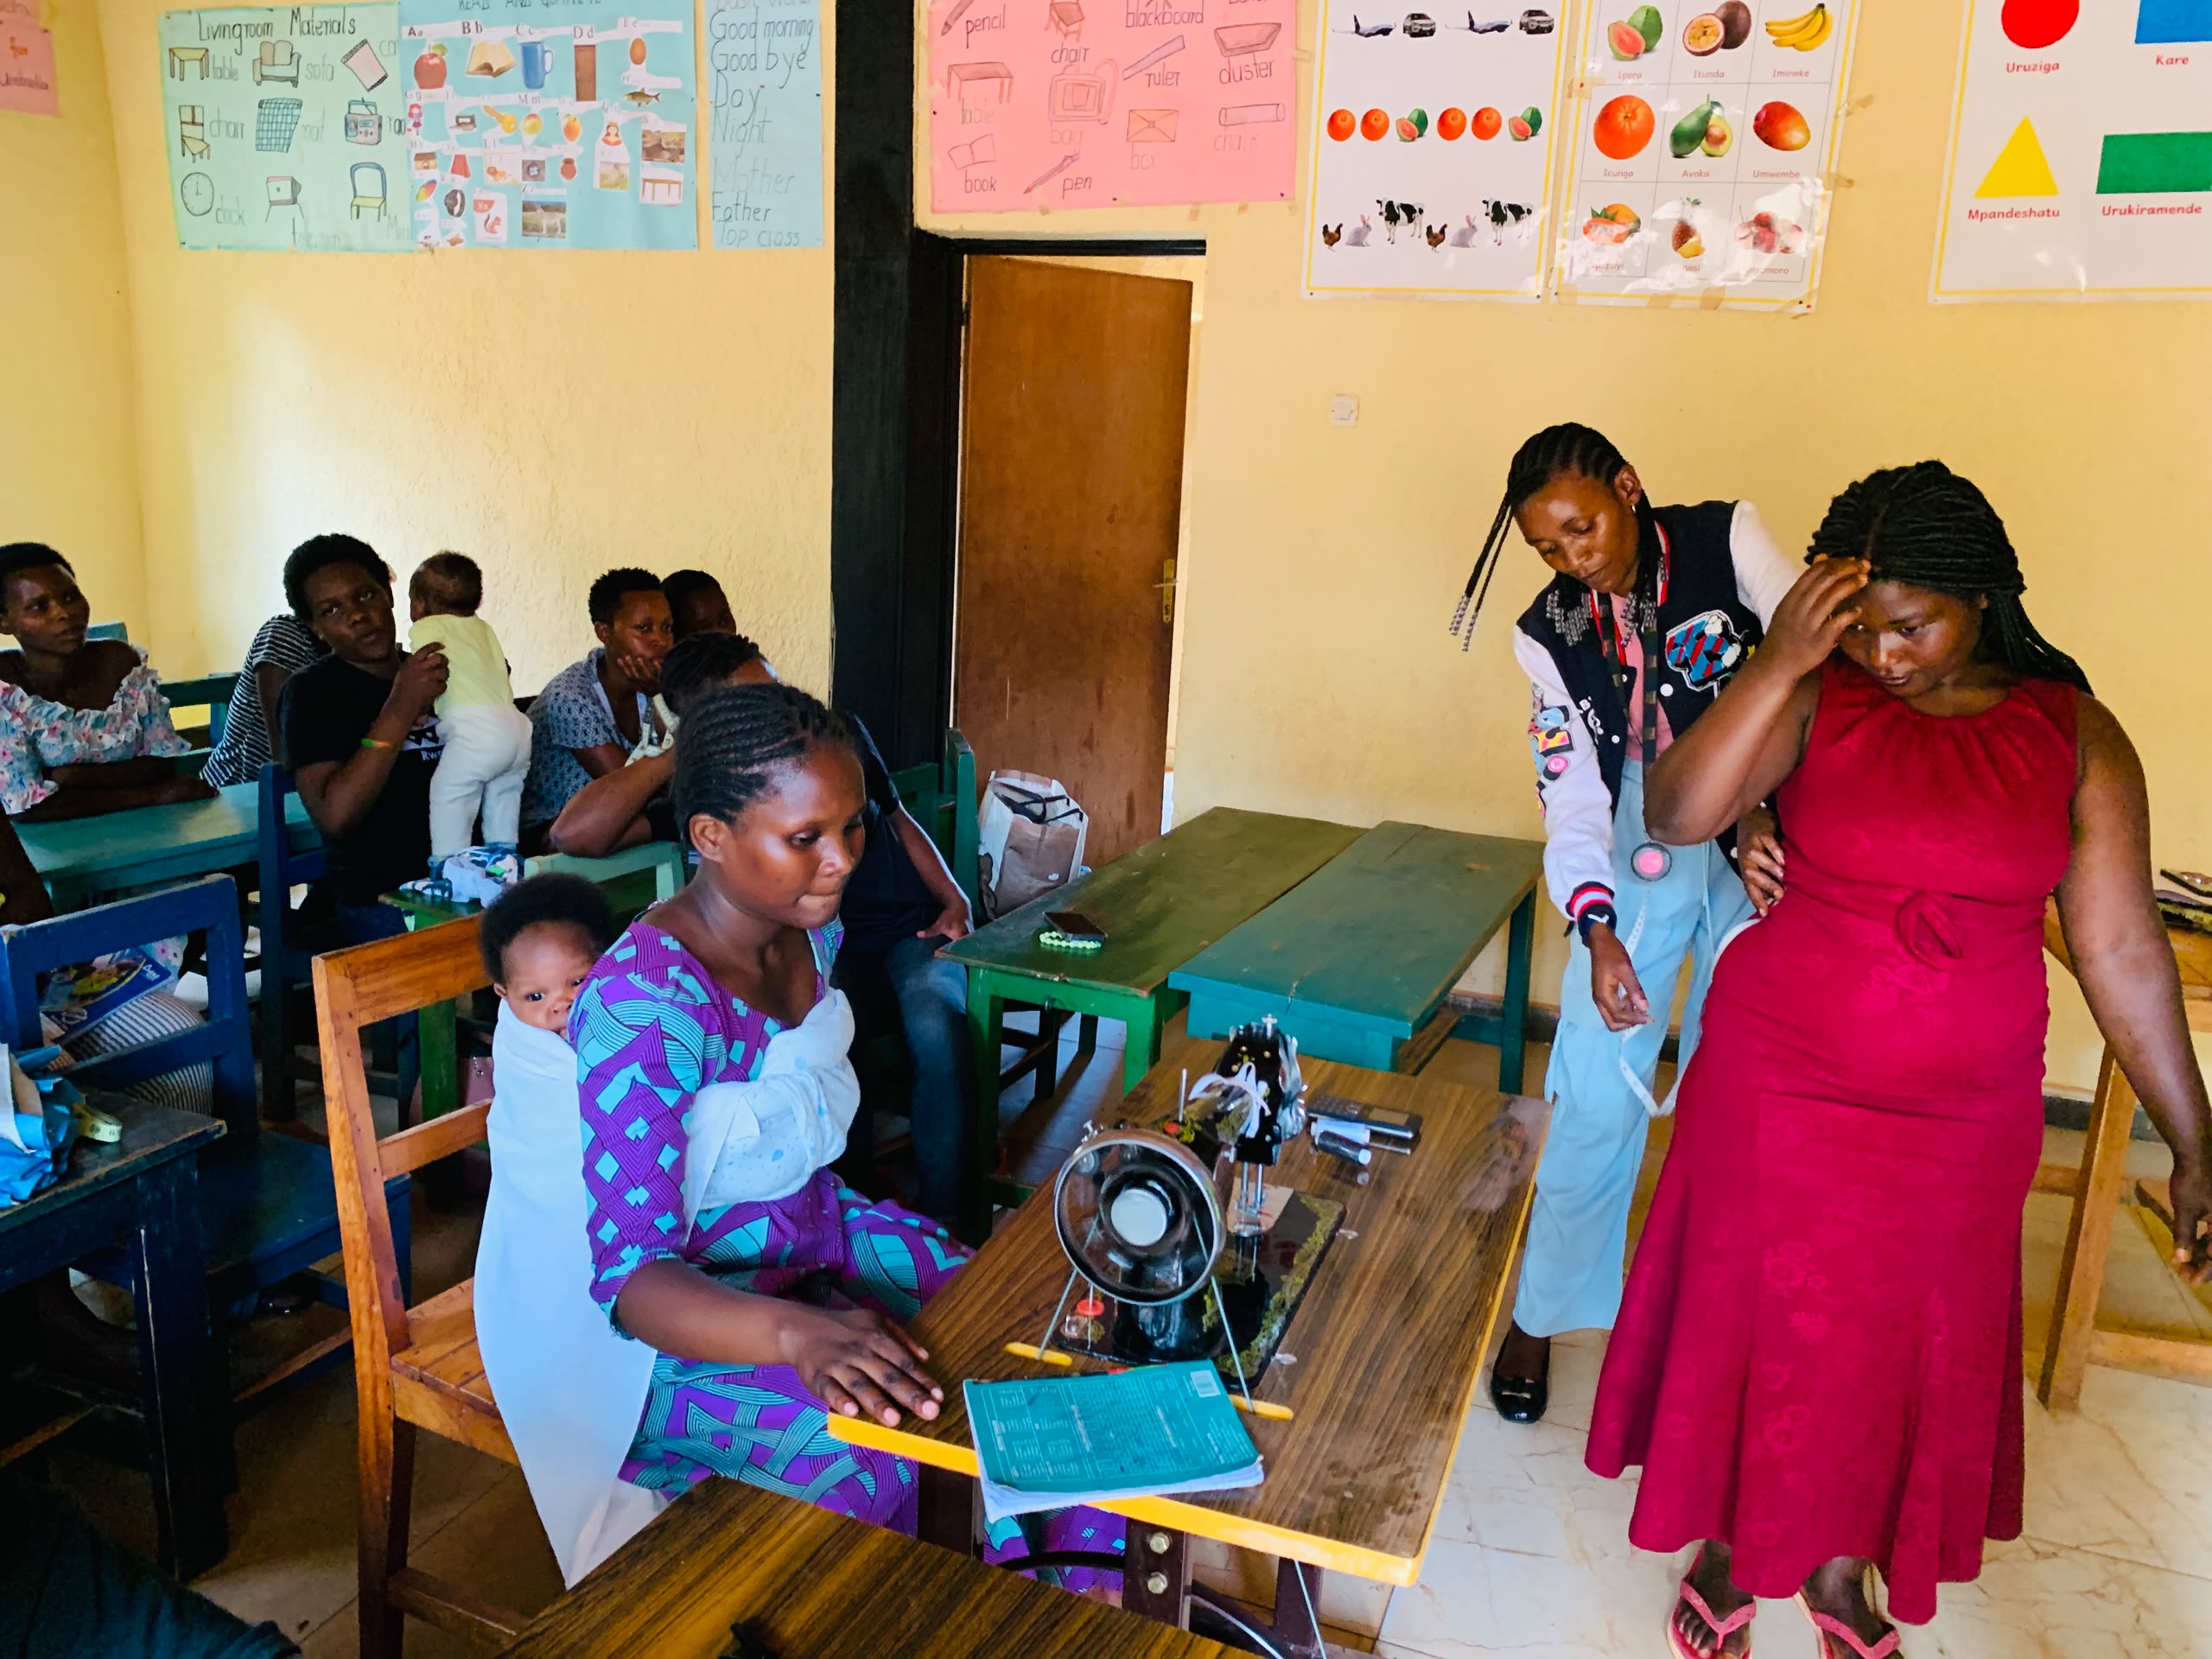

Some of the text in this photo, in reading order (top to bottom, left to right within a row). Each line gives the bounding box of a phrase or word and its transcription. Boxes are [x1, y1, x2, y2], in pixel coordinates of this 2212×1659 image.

[966, 3, 1006, 48] pencil
[1125, 0, 1204, 28] blackboard
[197, 7, 357, 55] Livingroom Materials
[709, 8, 813, 54] Good morning
[710, 38, 807, 89] Good bye
[1051, 41, 1090, 64] chair
[2156, 55, 2190, 66] Kare
[212, 54, 239, 81] table
[305, 53, 335, 81] sofa
[1145, 61, 1180, 88] ruler
[1218, 53, 1275, 84] duster
[1618, 70, 1643, 80] Ipera
[1694, 69, 1725, 79] Itunda
[1772, 68, 1809, 78] Imineke
[2006, 61, 2060, 73] Uruziga
[715, 70, 760, 126] Day
[209, 105, 245, 140] chair
[712, 106, 773, 158] Night
[714, 156, 795, 194] Mother
[965, 168, 996, 194] book
[1603, 168, 1634, 179] Icunga
[1682, 168, 1710, 178] Avoka
[1752, 169, 1801, 179] Umwembe
[1063, 176, 1092, 200] pen
[216, 193, 245, 226] clock
[712, 191, 772, 221] Father
[1967, 207, 2060, 222] Mpandeshatu
[2101, 204, 2202, 216] Urukiramende
